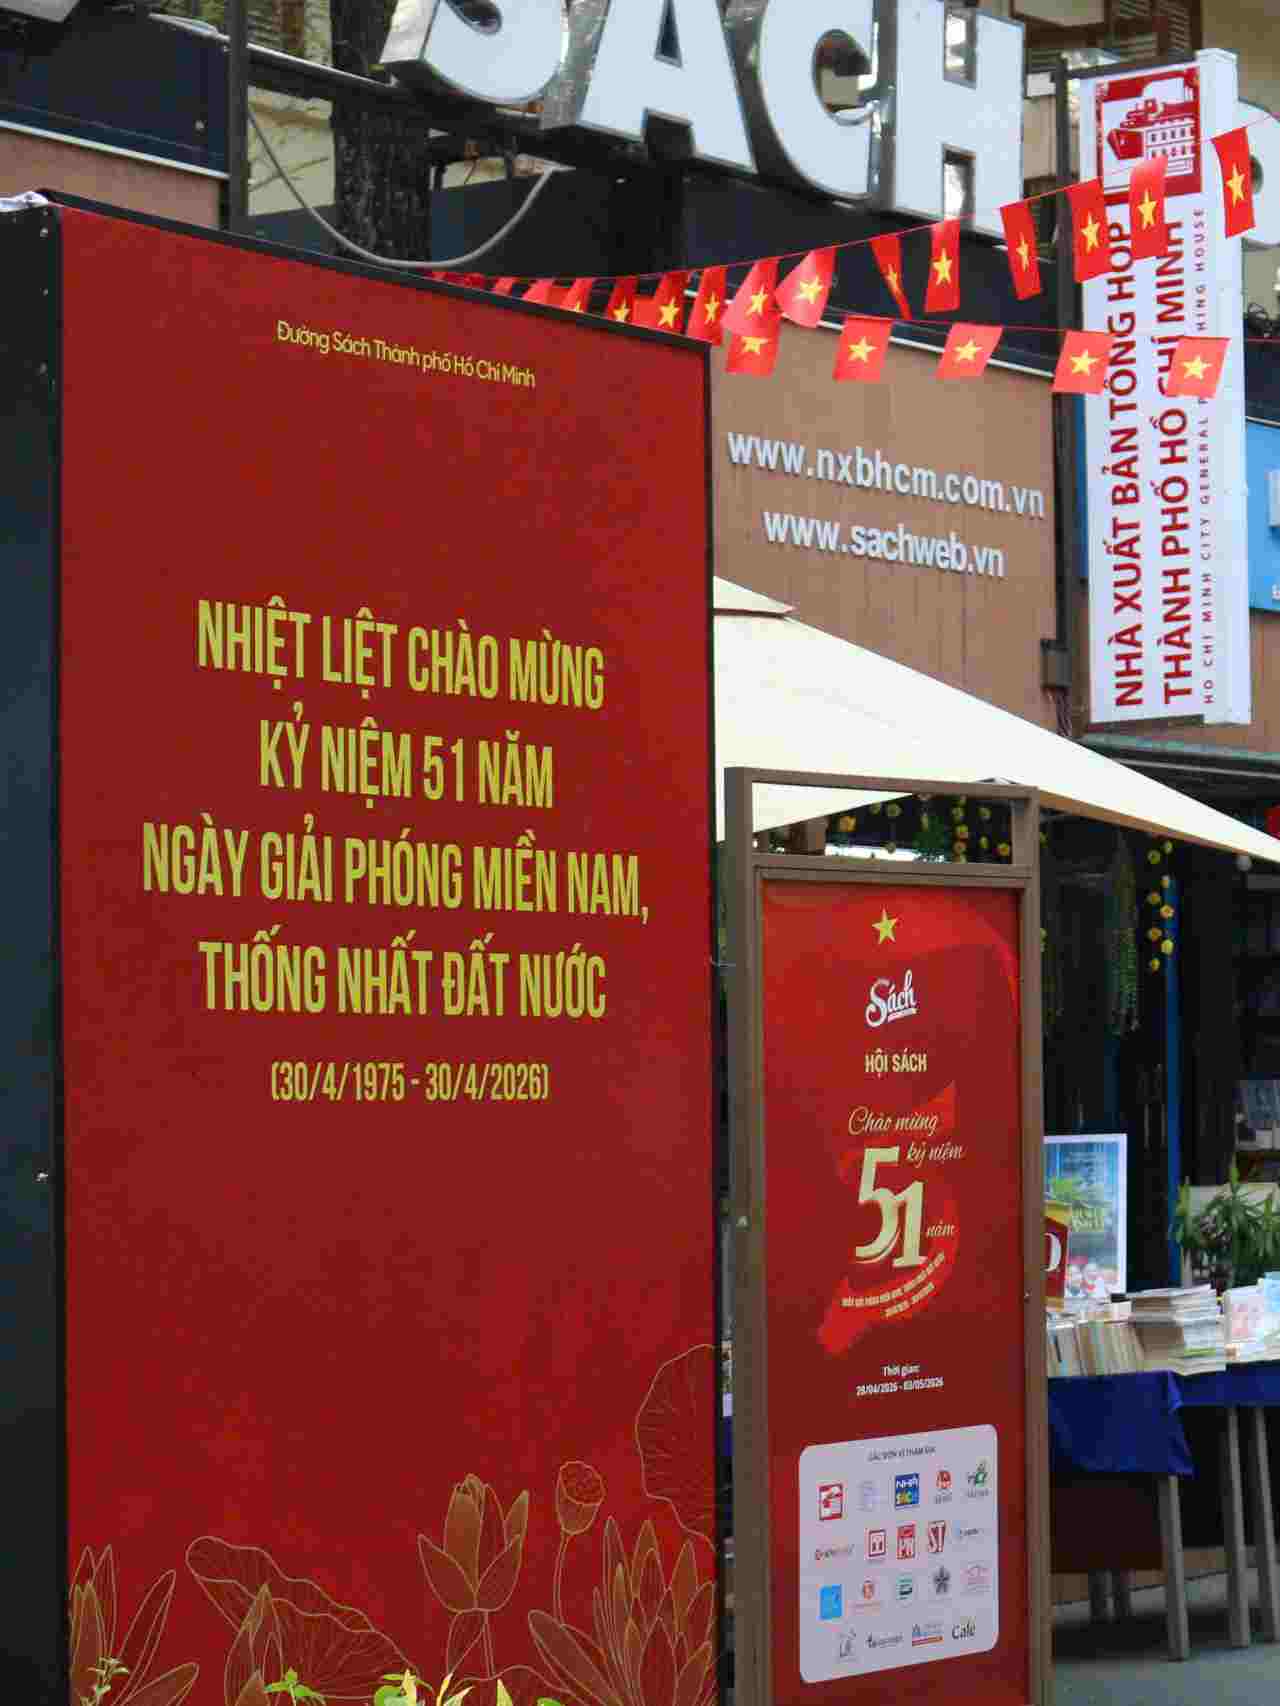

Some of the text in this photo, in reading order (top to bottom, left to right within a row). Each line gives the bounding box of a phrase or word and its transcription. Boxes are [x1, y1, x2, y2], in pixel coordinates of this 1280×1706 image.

[1194, 209, 1205, 272] HOUSE
[332, 331, 370, 357] Sách
[373, 340, 420, 366] Thành
[422, 351, 450, 373] phố
[475, 359, 500, 380] Chí
[501, 366, 536, 388] Minh
[1102, 428, 1140, 505] BẢN
[1150, 408, 1188, 464] HỒ
[1199, 416, 1209, 505] GENERAL
[727, 431, 1045, 519] www.nxbhcm.com.vn
[763, 511, 1005, 579] www.sachweb.vn
[1150, 475, 1190, 556] PHỐ
[1200, 518, 1211, 560] CITY
[1103, 518, 1142, 613] XUẤT
[1202, 573, 1212, 622] MINH
[197, 595, 604, 710] NHIỆT LIỆT CHÀO MỪNG
[1108, 625, 1143, 706] NHÀ
[1156, 568, 1192, 705] THÀNH
[1203, 634, 1213, 668] CHI
[1204, 679, 1213, 704] HO
[259, 702, 553, 809] KỶ NIỆM 51 NĂM
[142, 813, 649, 925] NGÀY GIẢI PHÓNG MIỀN NAM,
[198, 924, 607, 1019] THỐNG NHẤT ĐẤT NƯỚC
[865, 968, 918, 1028] Sách
[271, 1062, 405, 1101] (30/4/1975
[424, 1063, 549, 1102] 30/4/2026)
[865, 1047, 928, 1078] HỘI SÁCH
[848, 1105, 891, 1136] Chào
[856, 1146, 928, 1267] 51
